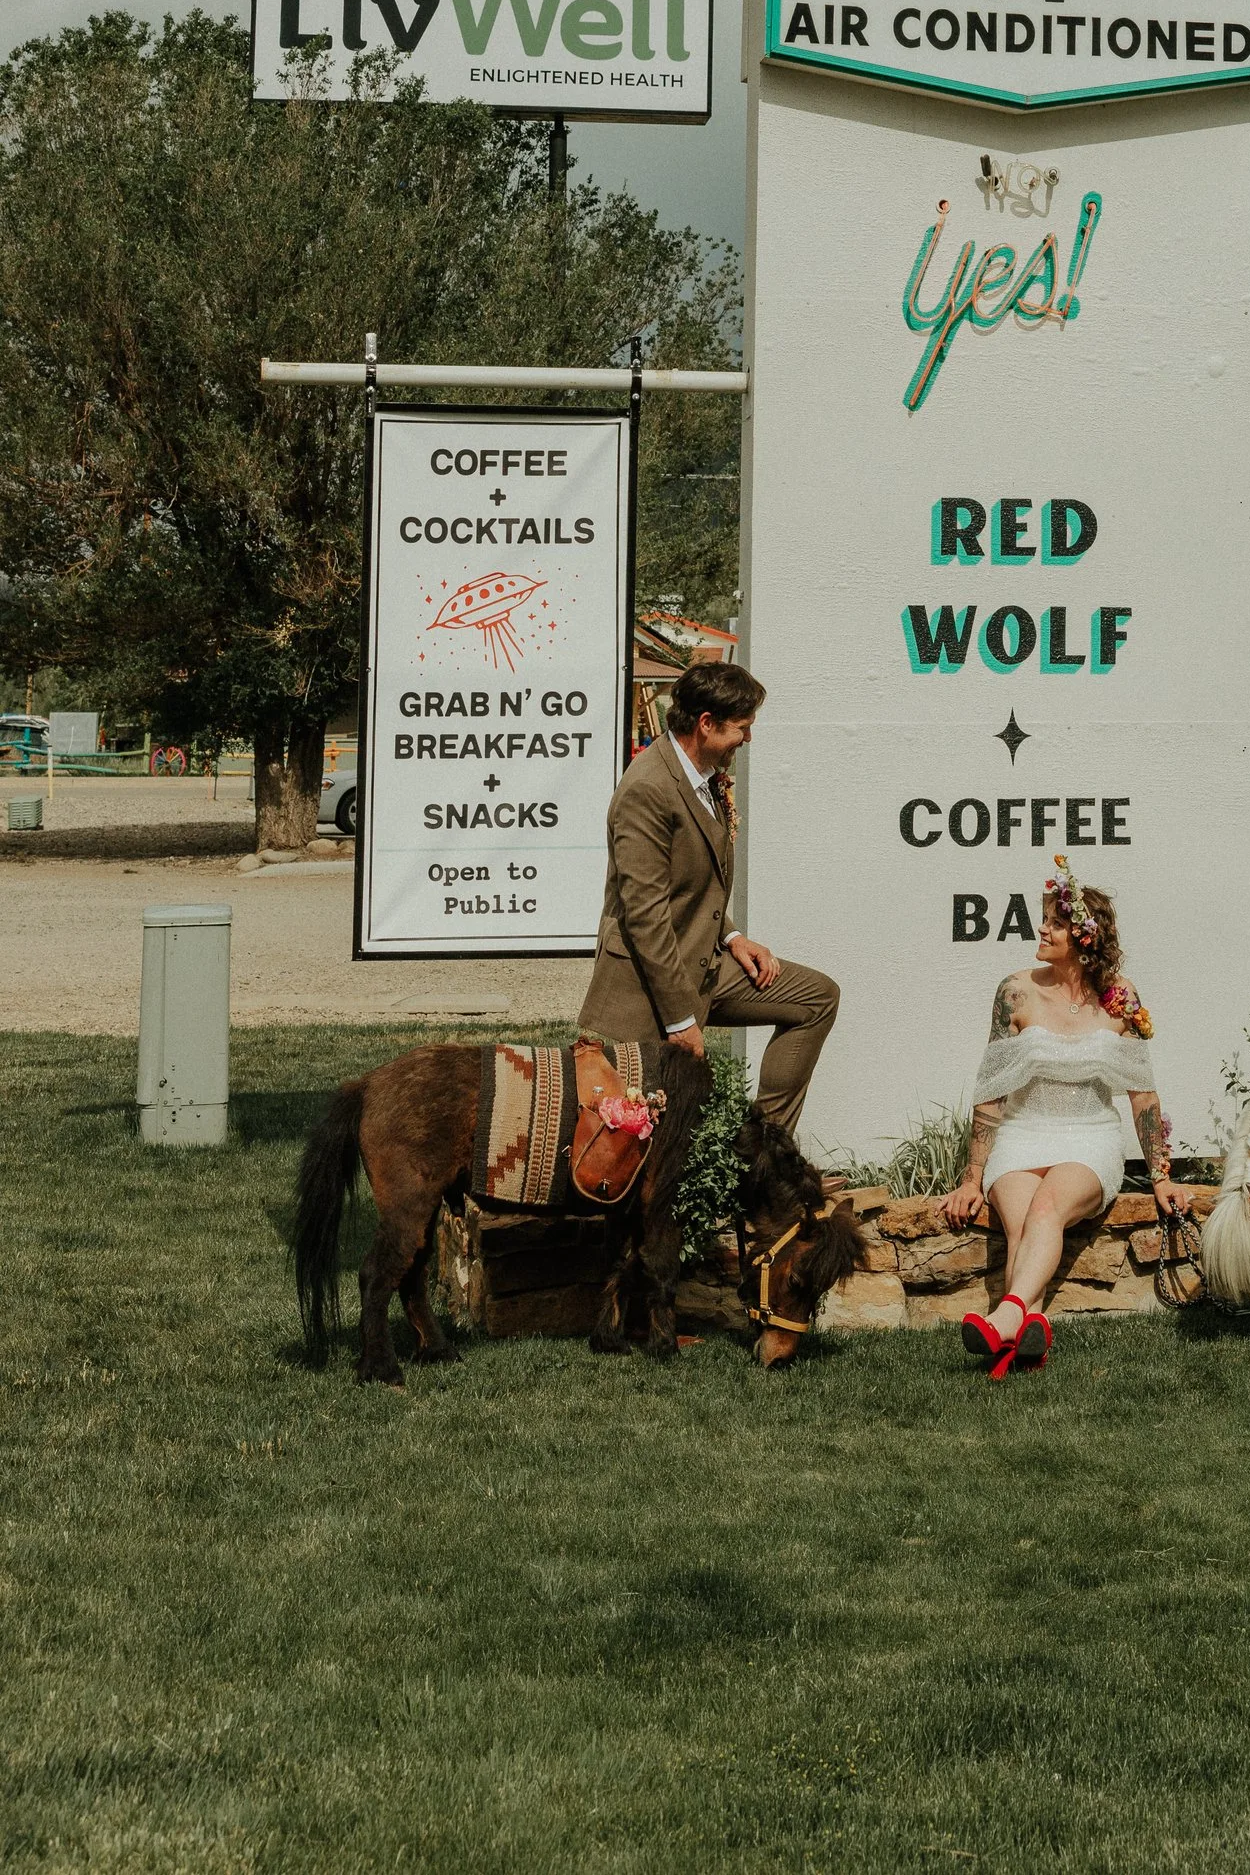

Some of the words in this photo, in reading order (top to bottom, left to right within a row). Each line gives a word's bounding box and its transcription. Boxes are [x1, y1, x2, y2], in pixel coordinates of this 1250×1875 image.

[784, 3, 869, 47] AIR
[470, 68, 604, 85] ENLIGHTENED
[610, 72, 684, 88] HEALTH
[430, 448, 568, 477] COFFEE
[399, 516, 595, 544] COCKTAILS
[930, 497, 1098, 566] RED
[900, 605, 1132, 674] WOLF
[399, 691, 490, 717] GRAB
[540, 691, 588, 716] GO
[394, 733, 592, 759] BREAKFAST
[423, 803, 559, 829] SNACKS
[899, 798, 1131, 848] COFFEE
[428, 863, 491, 886] Open
[507, 862, 538, 881] to
[444, 894, 537, 915] Public
[952, 893, 1045, 942] BA
